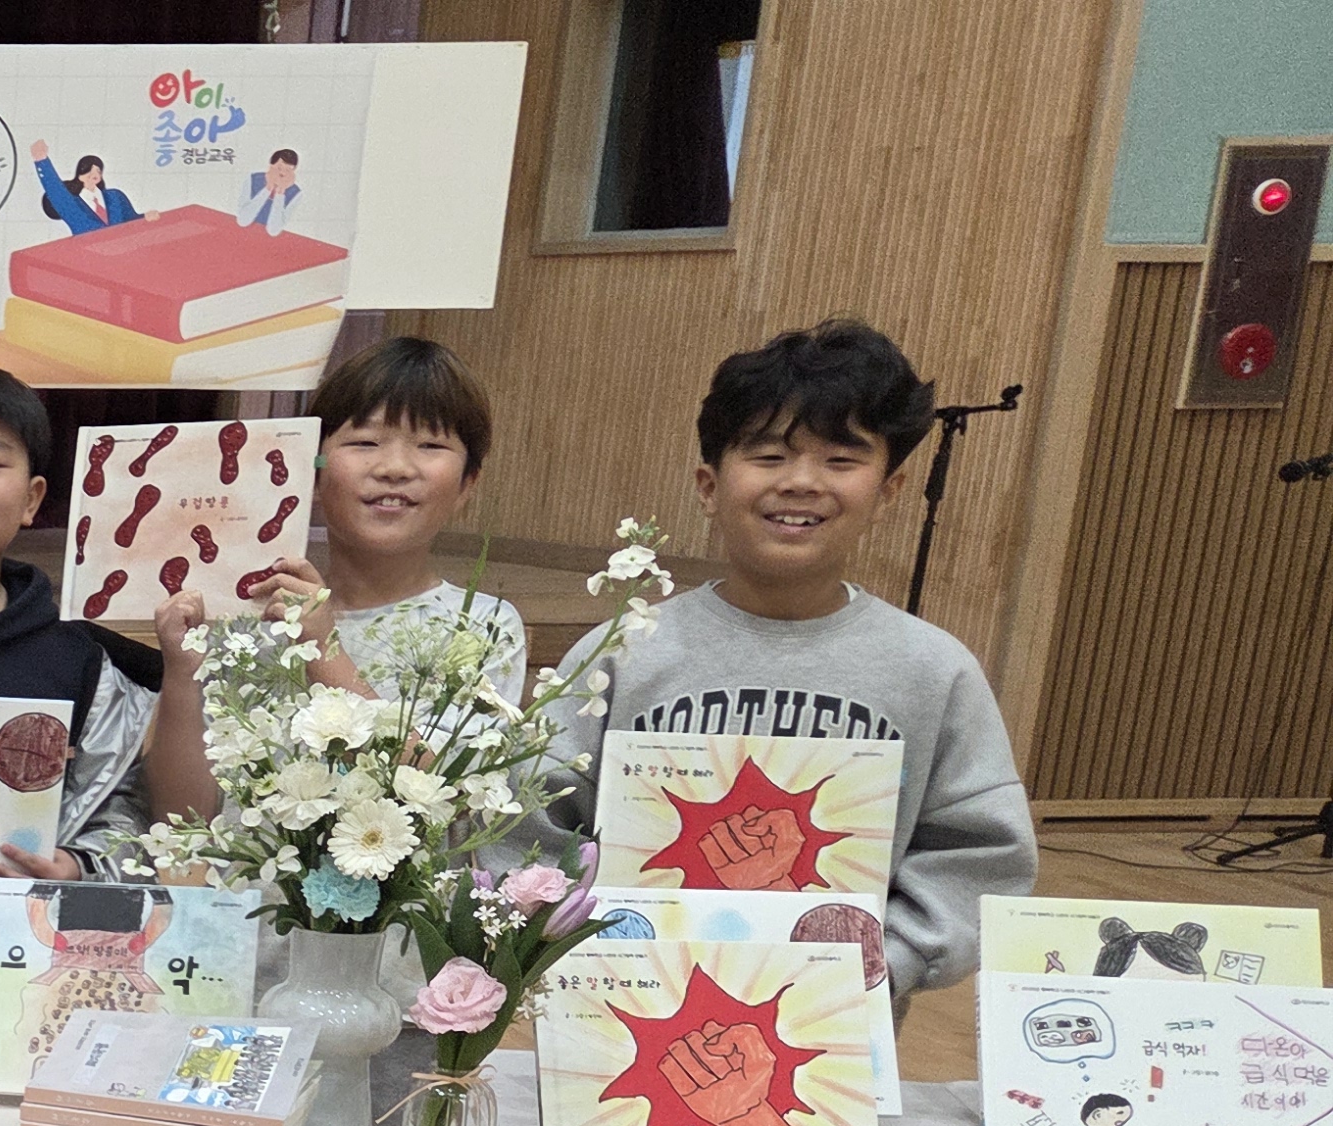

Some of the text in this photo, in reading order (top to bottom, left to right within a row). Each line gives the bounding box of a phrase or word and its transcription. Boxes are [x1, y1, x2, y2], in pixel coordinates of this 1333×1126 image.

[182, 147, 235, 166] 경남교육
[1, 945, 27, 969] 으
[558, 975, 582, 990] 좋은
[1142, 1039, 1168, 1057] 급식
